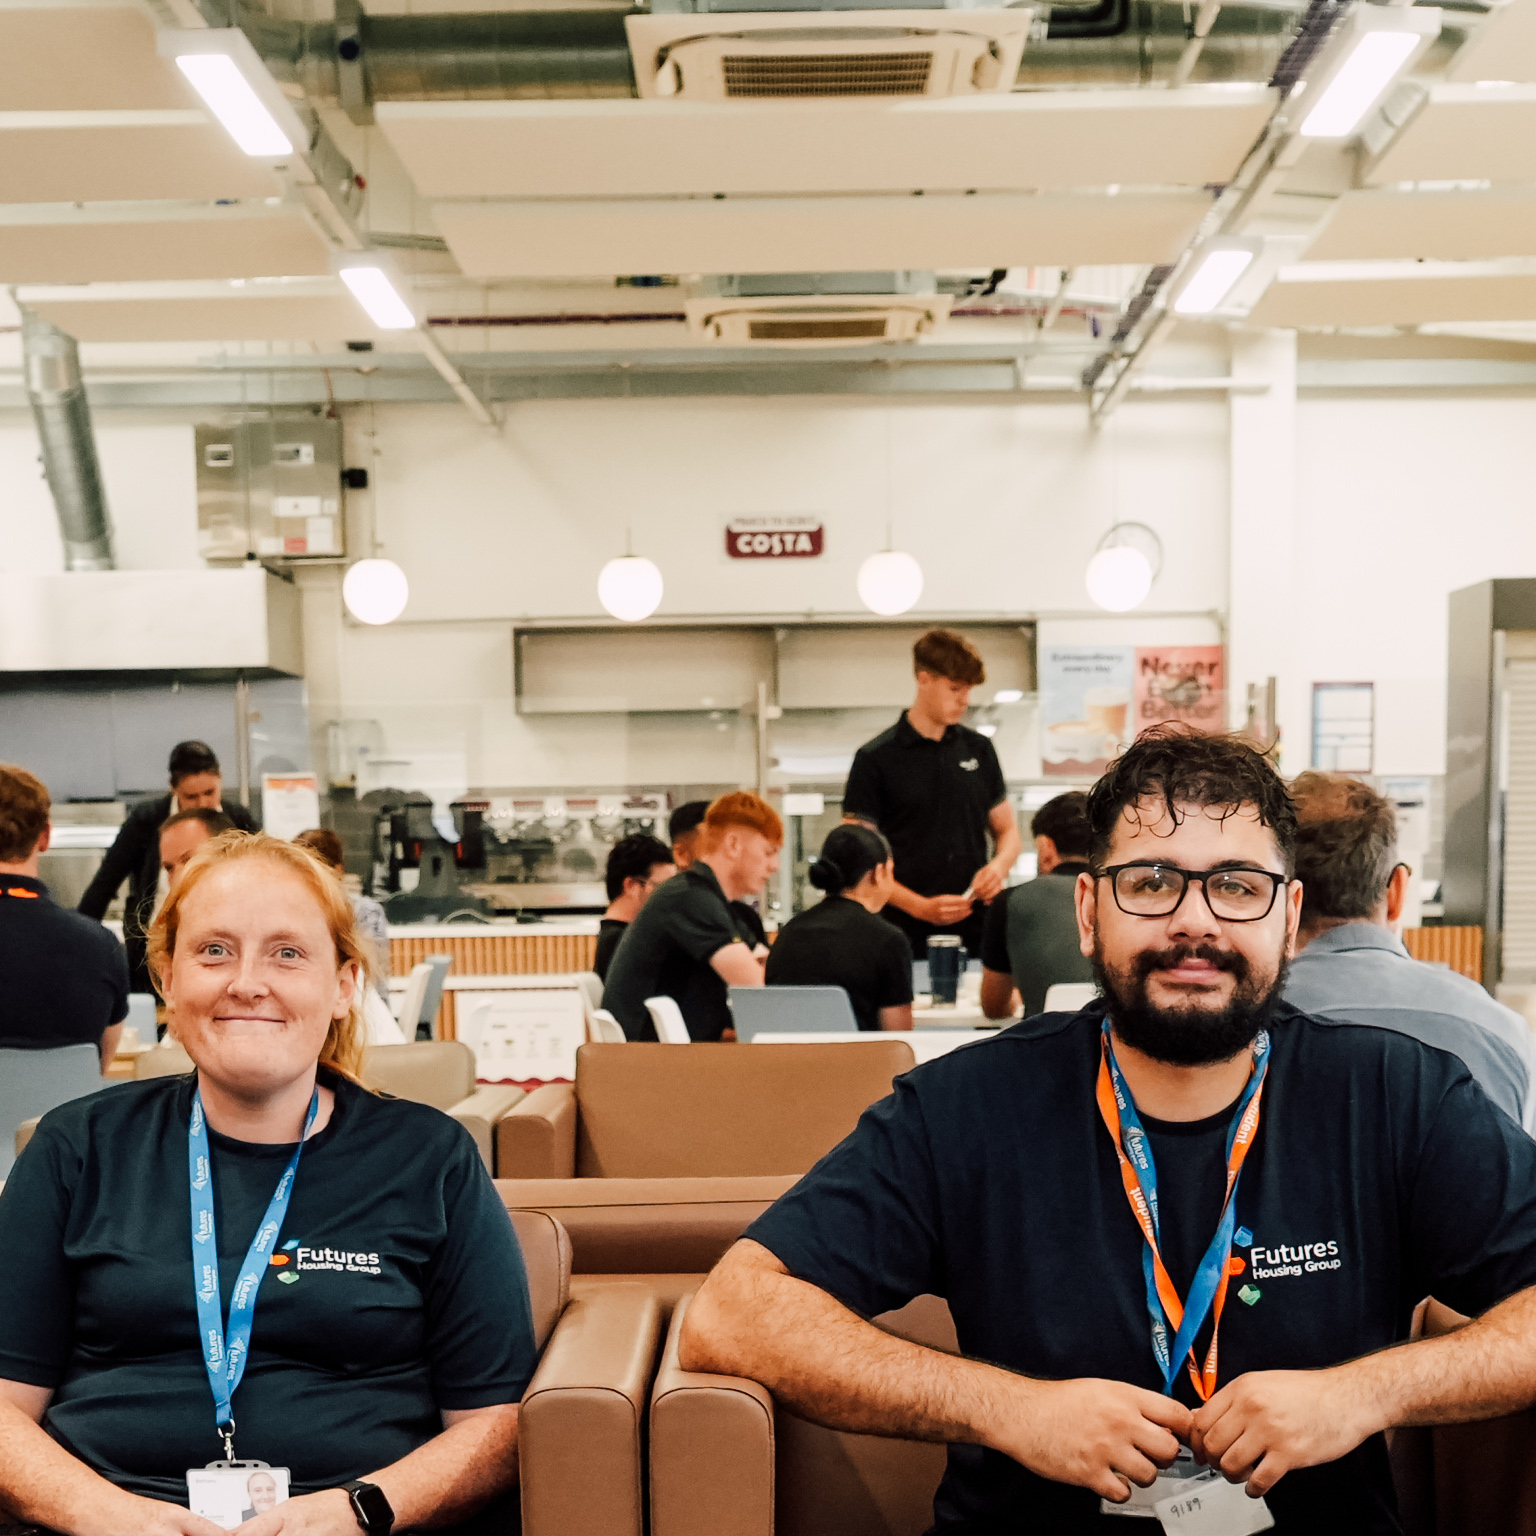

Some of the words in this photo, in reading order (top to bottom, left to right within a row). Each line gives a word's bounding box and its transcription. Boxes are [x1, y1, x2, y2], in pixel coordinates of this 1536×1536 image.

[736, 533, 813, 555] COSTA
[1130, 1136, 1149, 1170] futures
[296, 1247, 380, 1265] Futures
[1250, 1240, 1339, 1267] Futures
[296, 1261, 344, 1272] Housing
[345, 1264, 382, 1275] Group
[1252, 1264, 1302, 1280] Housing
[1304, 1258, 1342, 1272] Group
[208, 1329, 220, 1362] futures
[226, 1349, 241, 1381] futures
